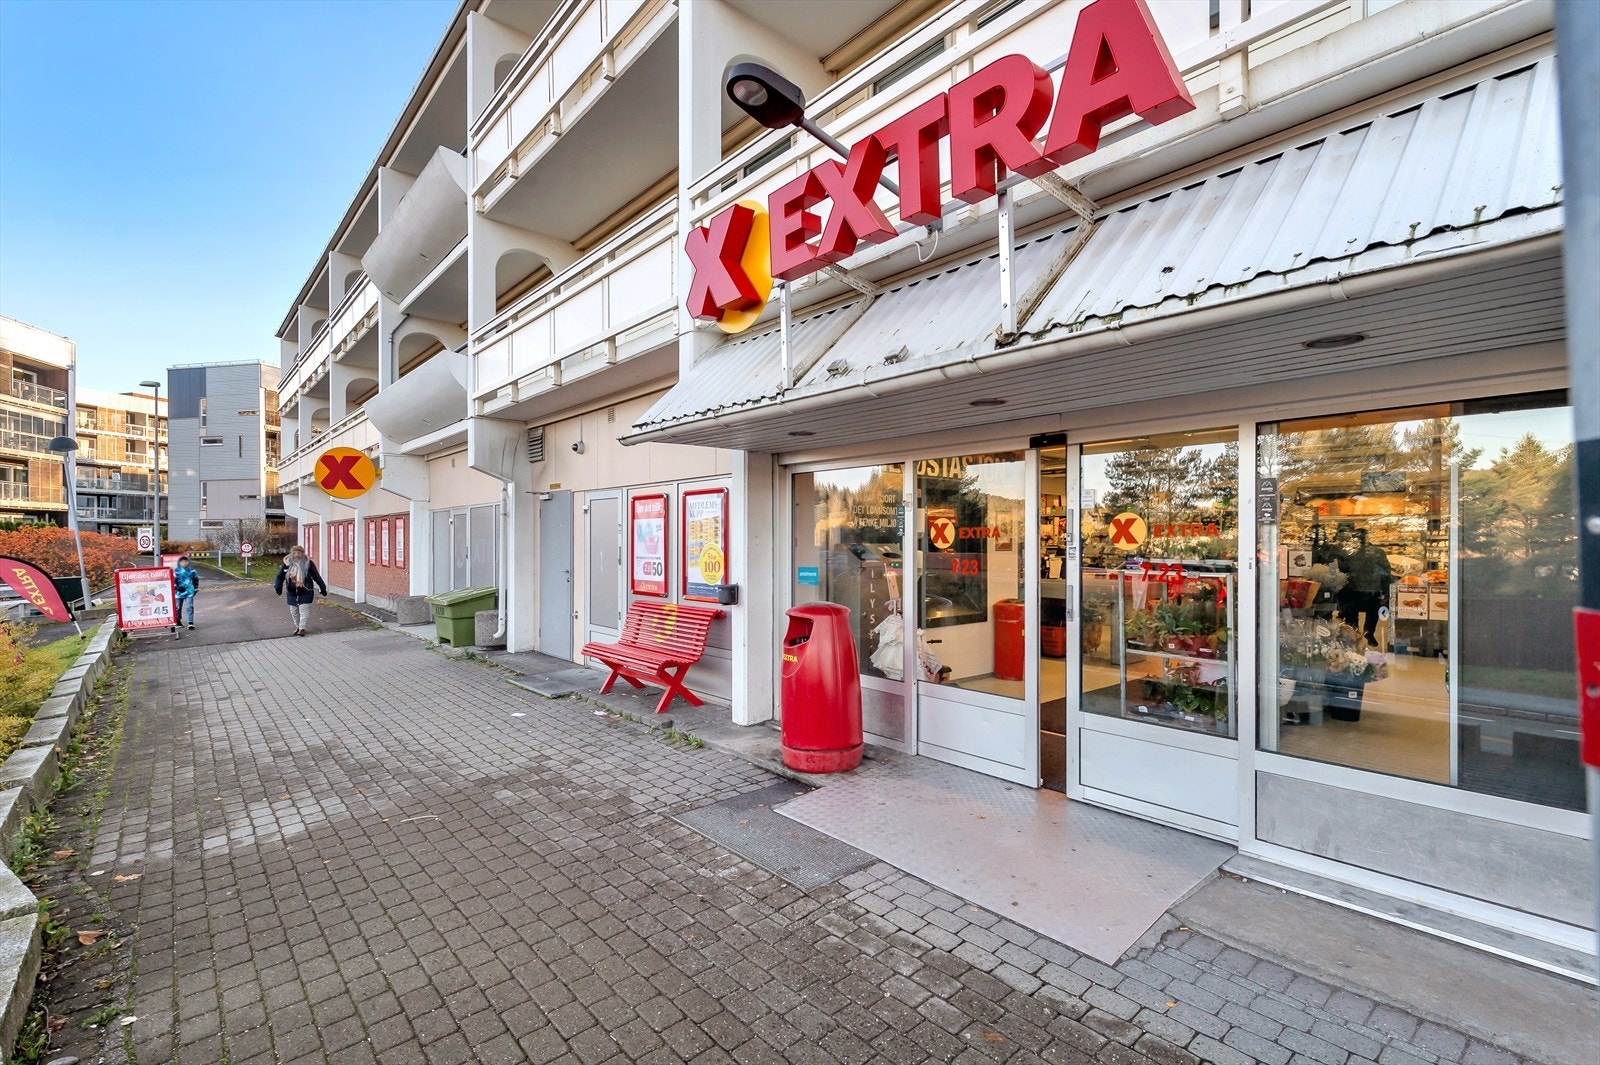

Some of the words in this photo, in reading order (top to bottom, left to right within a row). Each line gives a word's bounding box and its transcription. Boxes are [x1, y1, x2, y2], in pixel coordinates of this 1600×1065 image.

[768, 0, 1196, 281] EXTRA
[959, 526, 1001, 539] EXTRA
[1153, 523, 1219, 538] EXTRA
[142, 538, 149, 546] 30
[652, 562, 663, 576] 50
[704, 560, 721, 573] 100
[153, 605, 169, 615] 45
